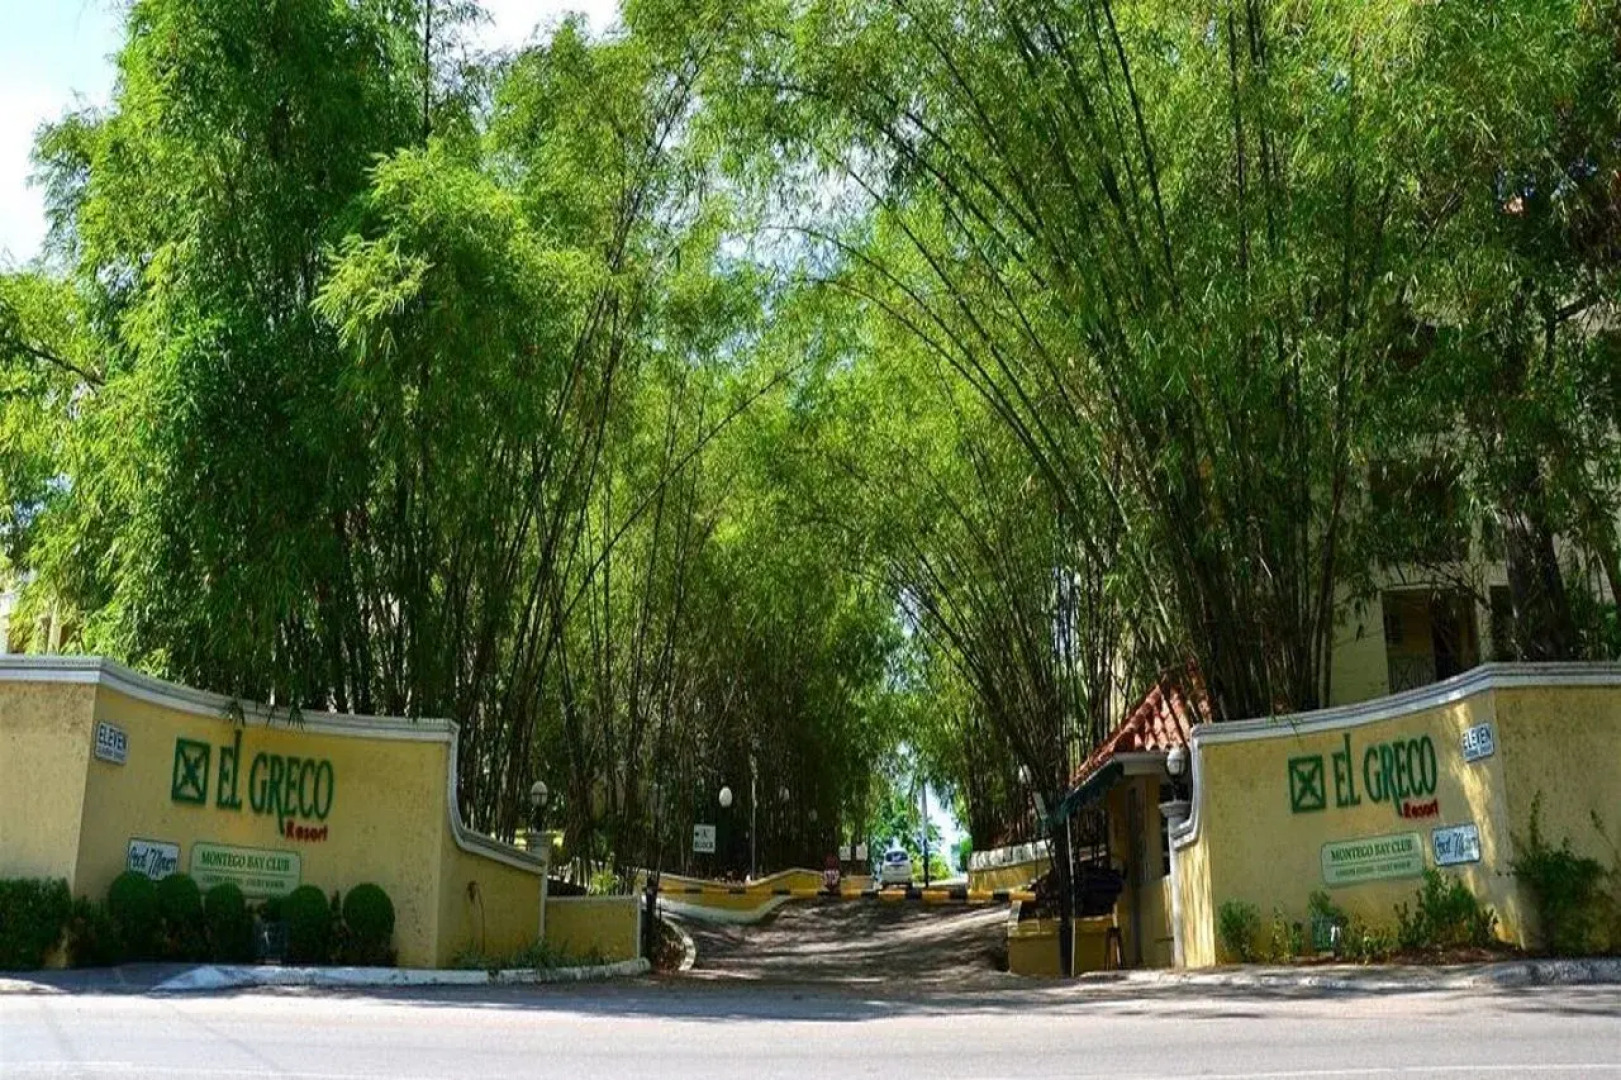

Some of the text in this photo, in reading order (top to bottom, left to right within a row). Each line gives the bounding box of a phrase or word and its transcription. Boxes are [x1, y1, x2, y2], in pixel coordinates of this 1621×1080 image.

[1363, 735, 1437, 816] GRECO
[249, 751, 334, 834] GRECO
[1402, 799, 1439, 819] Resort
[284, 819, 328, 842] Resort
[1330, 838, 1413, 861] MONTEGO BAY CLUB
[202, 851, 290, 872] MONTEGO BAY CLUB
